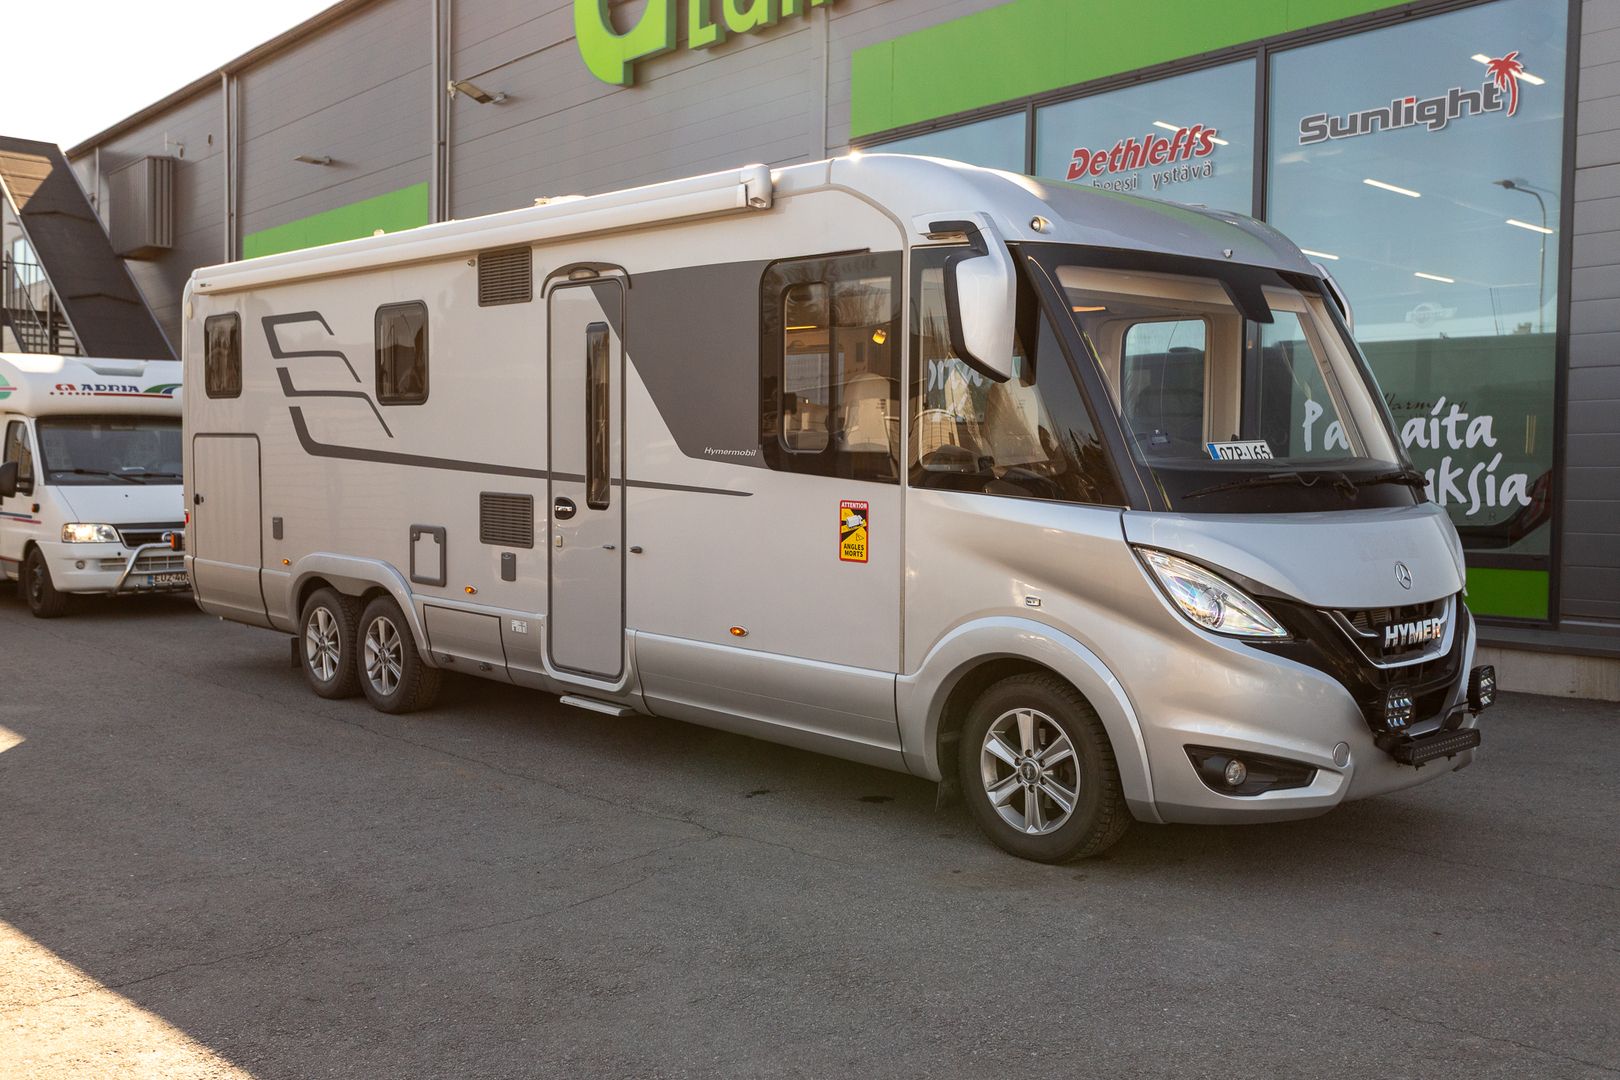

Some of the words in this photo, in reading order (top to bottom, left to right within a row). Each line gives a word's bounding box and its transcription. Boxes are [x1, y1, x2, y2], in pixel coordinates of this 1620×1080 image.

[1299, 79, 1504, 145] Sunlight
[1065, 123, 1217, 181] Dethleffs
[1092, 172, 1138, 191] heesi
[1152, 160, 1215, 191] ystävä
[81, 383, 140, 393] ADRIA
[1302, 396, 1498, 452] Paaita
[703, 446, 757, 457] Hymermobil
[841, 501, 867, 509] ATTENTION
[843, 543, 865, 551] ANGLES
[844, 550, 864, 558] MORTS
[1384, 617, 1441, 648] HYMER
